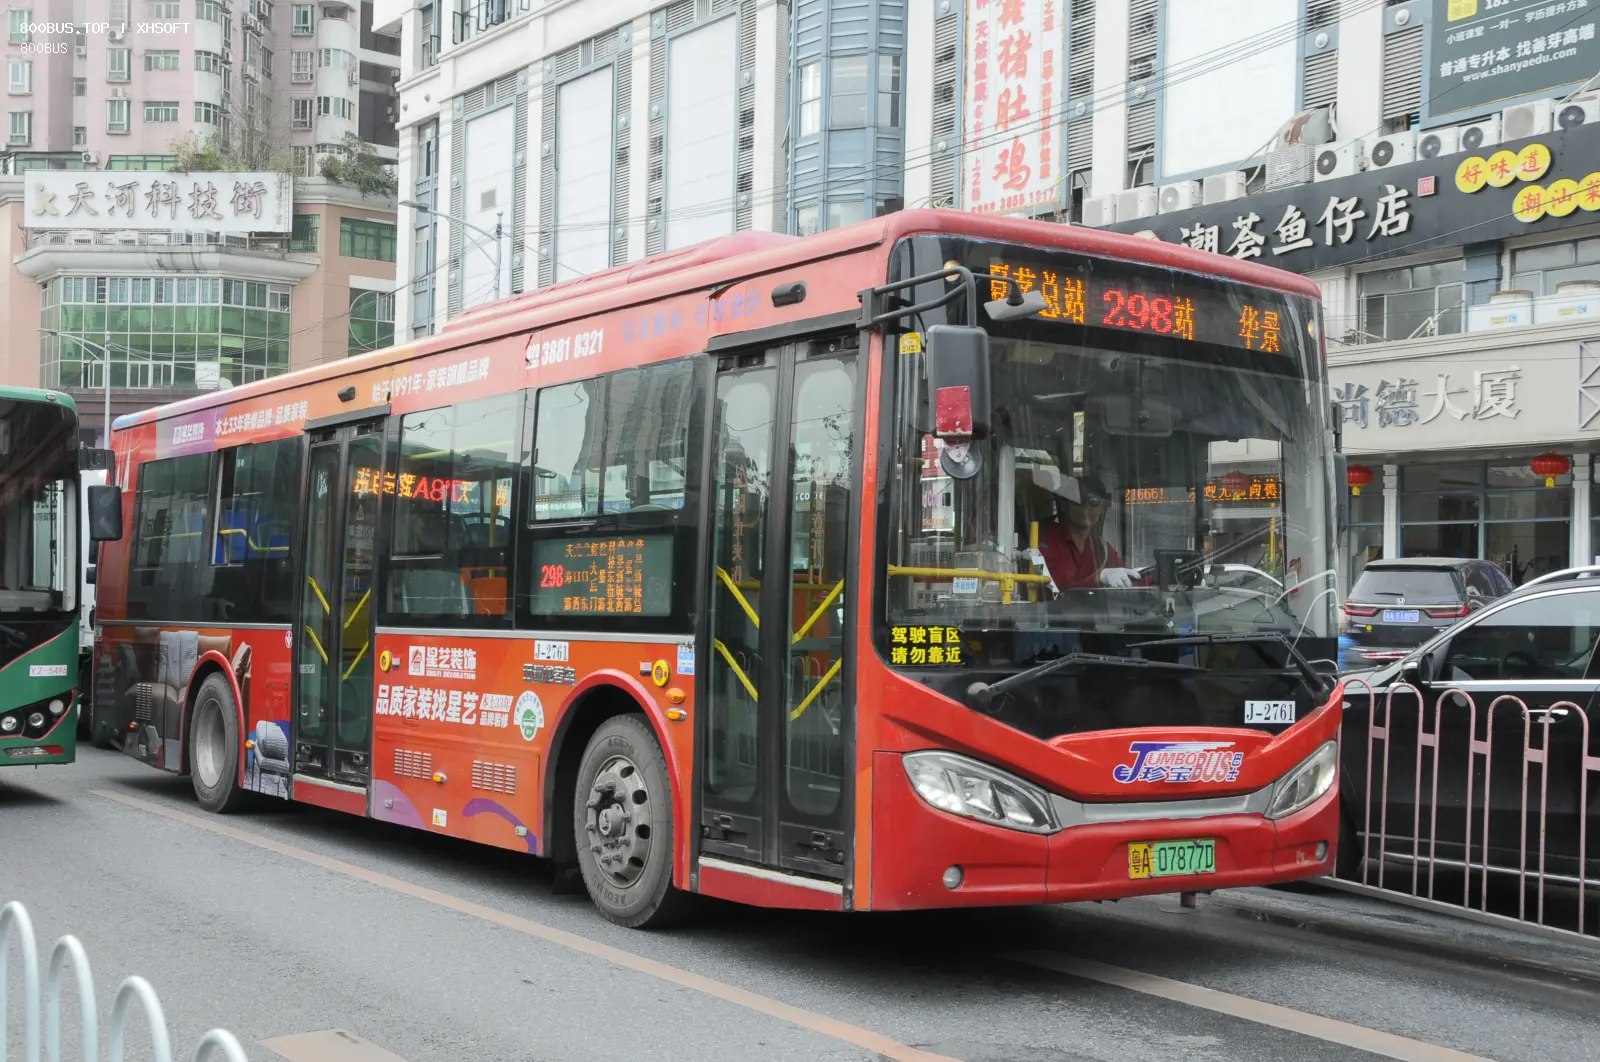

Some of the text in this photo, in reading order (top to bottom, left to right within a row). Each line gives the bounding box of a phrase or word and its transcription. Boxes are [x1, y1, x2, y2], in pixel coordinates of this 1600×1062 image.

[1440, 47, 1511, 77] 普通专升本
[1463, 47, 1577, 83] www.shanyaedu.com
[1461, 151, 1543, 184] 好味道
[66, 181, 266, 220] 天河科技街
[1180, 184, 1411, 259] 潮荟鱼仔店
[1103, 289, 1173, 333] 298
[1239, 305, 1281, 352] 华景
[1332, 365, 1523, 430] 尚德大厦
[540, 564, 565, 588] 298
[891, 626, 961, 644] 驾驶盲区
[426, 646, 477, 670] 星艺装饰
[535, 643, 568, 661] J-2761
[891, 647, 961, 664] 请勿靠近
[375, 684, 479, 725] 品质家装找星艺
[1246, 703, 1295, 721] J-2761
[1139, 767, 1194, 782] 珍宝
[1158, 845, 1214, 872] 07877D
